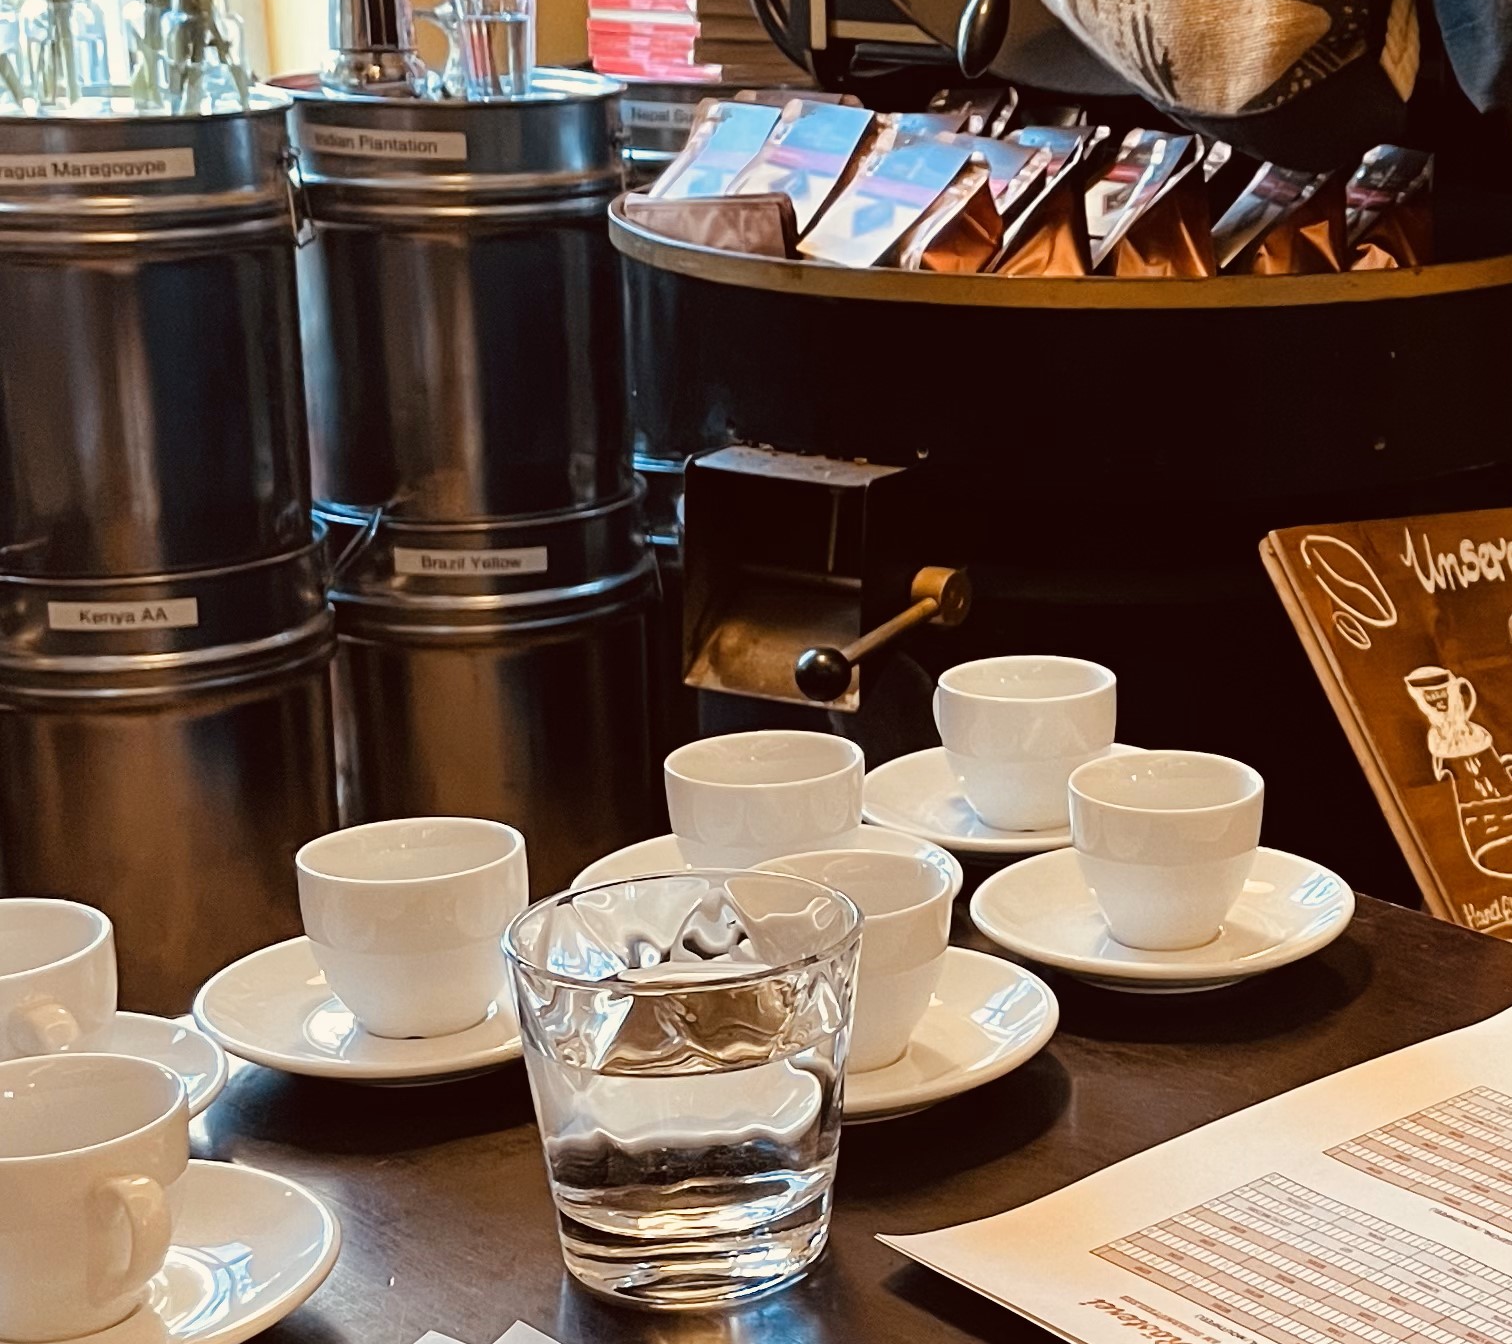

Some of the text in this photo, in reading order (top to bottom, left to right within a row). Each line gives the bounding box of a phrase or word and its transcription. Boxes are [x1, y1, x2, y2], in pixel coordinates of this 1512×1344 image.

[314, 133, 438, 154] Indian Plantation
[52, 160, 167, 179] Maragogype
[421, 555, 523, 570] Brazil Yellow
[79, 607, 169, 626] Kenya AA
